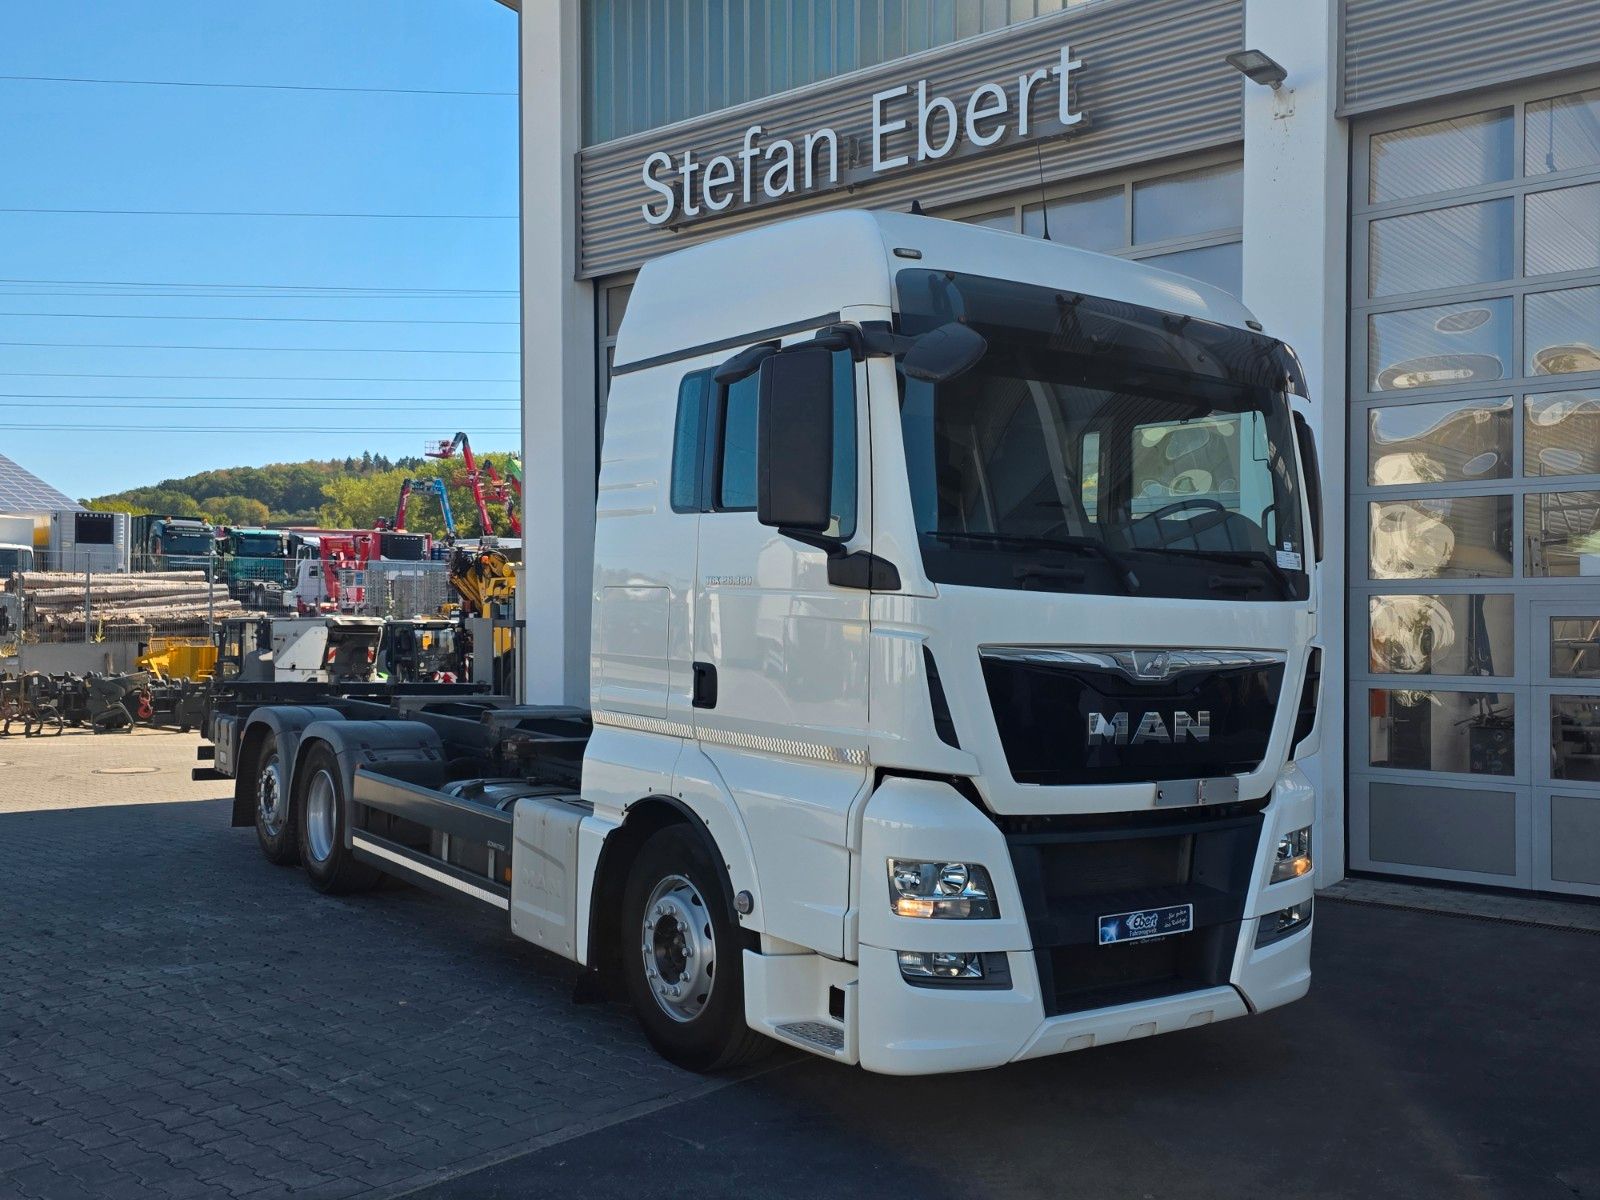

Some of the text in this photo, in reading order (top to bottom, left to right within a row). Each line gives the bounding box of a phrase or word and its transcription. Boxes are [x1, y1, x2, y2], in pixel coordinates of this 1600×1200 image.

[641, 45, 1083, 226] Stefan Ebert
[1088, 710, 1210, 745] MAN
[1133, 913, 1158, 930] Ebert
